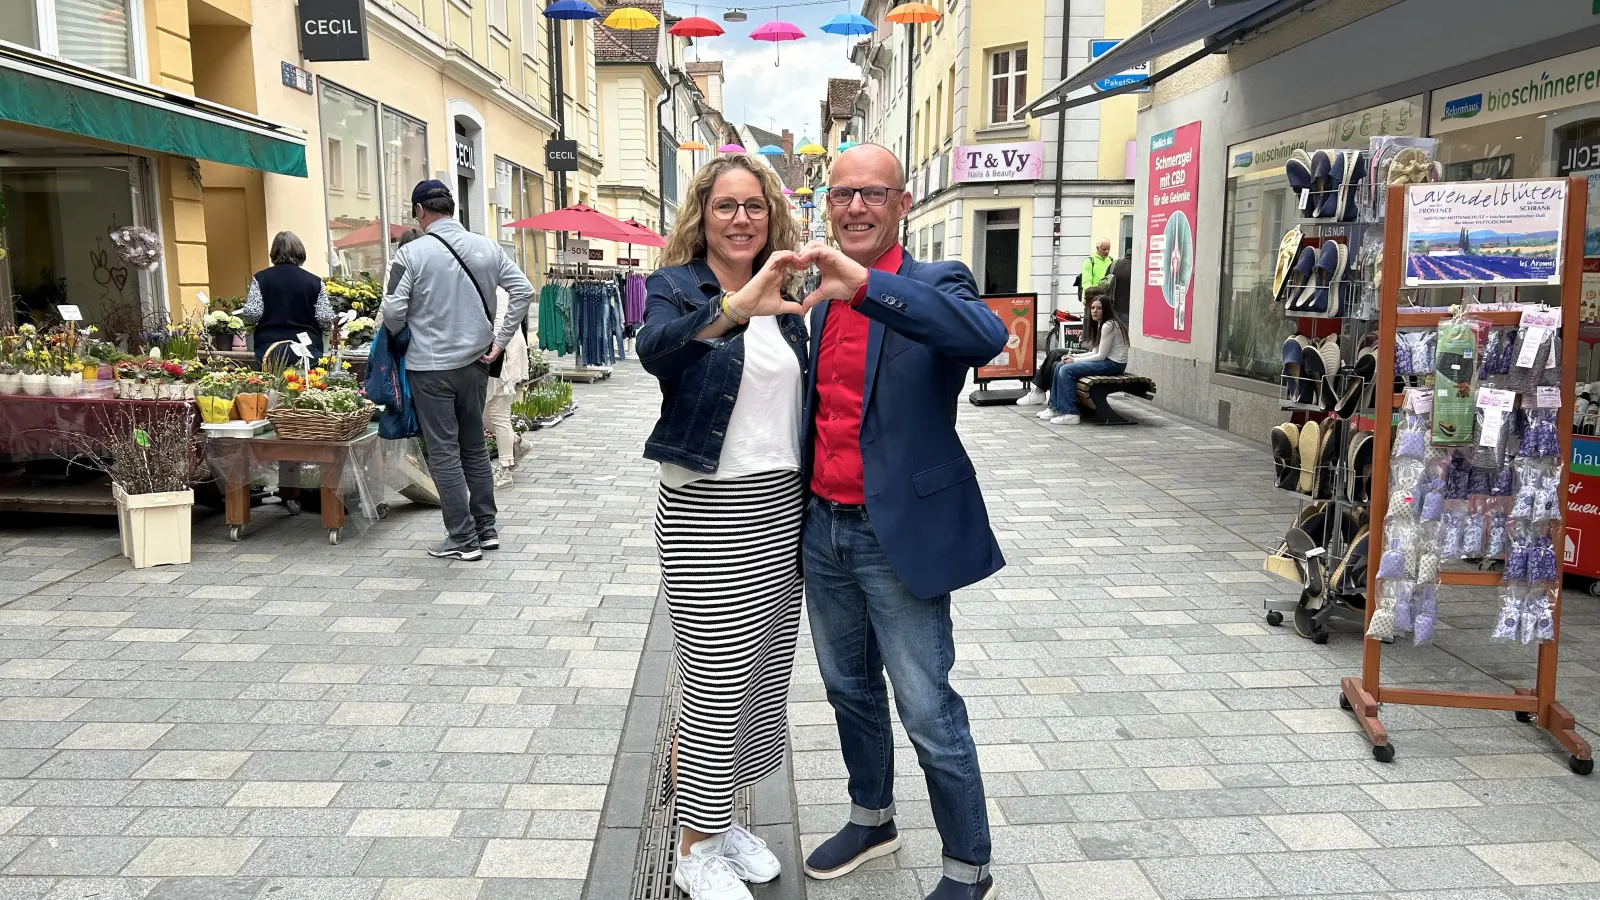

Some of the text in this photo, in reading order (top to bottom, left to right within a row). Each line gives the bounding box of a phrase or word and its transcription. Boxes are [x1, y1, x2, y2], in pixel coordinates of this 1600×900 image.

[304, 19, 358, 35] CECIL
[1445, 102, 1479, 118] Reformhaus
[1152, 137, 1167, 149] Endlich
[549, 151, 576, 160] CECIL
[967, 149, 1031, 172] T & Vy
[1155, 146, 1193, 171] Schmerzgel
[985, 170, 990, 178] &
[992, 169, 1016, 178] Beauty
[1160, 169, 1186, 188] mit CBD
[1153, 188, 1191, 207] für die Gelenke
[1411, 182, 1564, 208] Lavendelblüten
[568, 246, 588, 256] -50%
[1519, 259, 1556, 268] les Aromes
